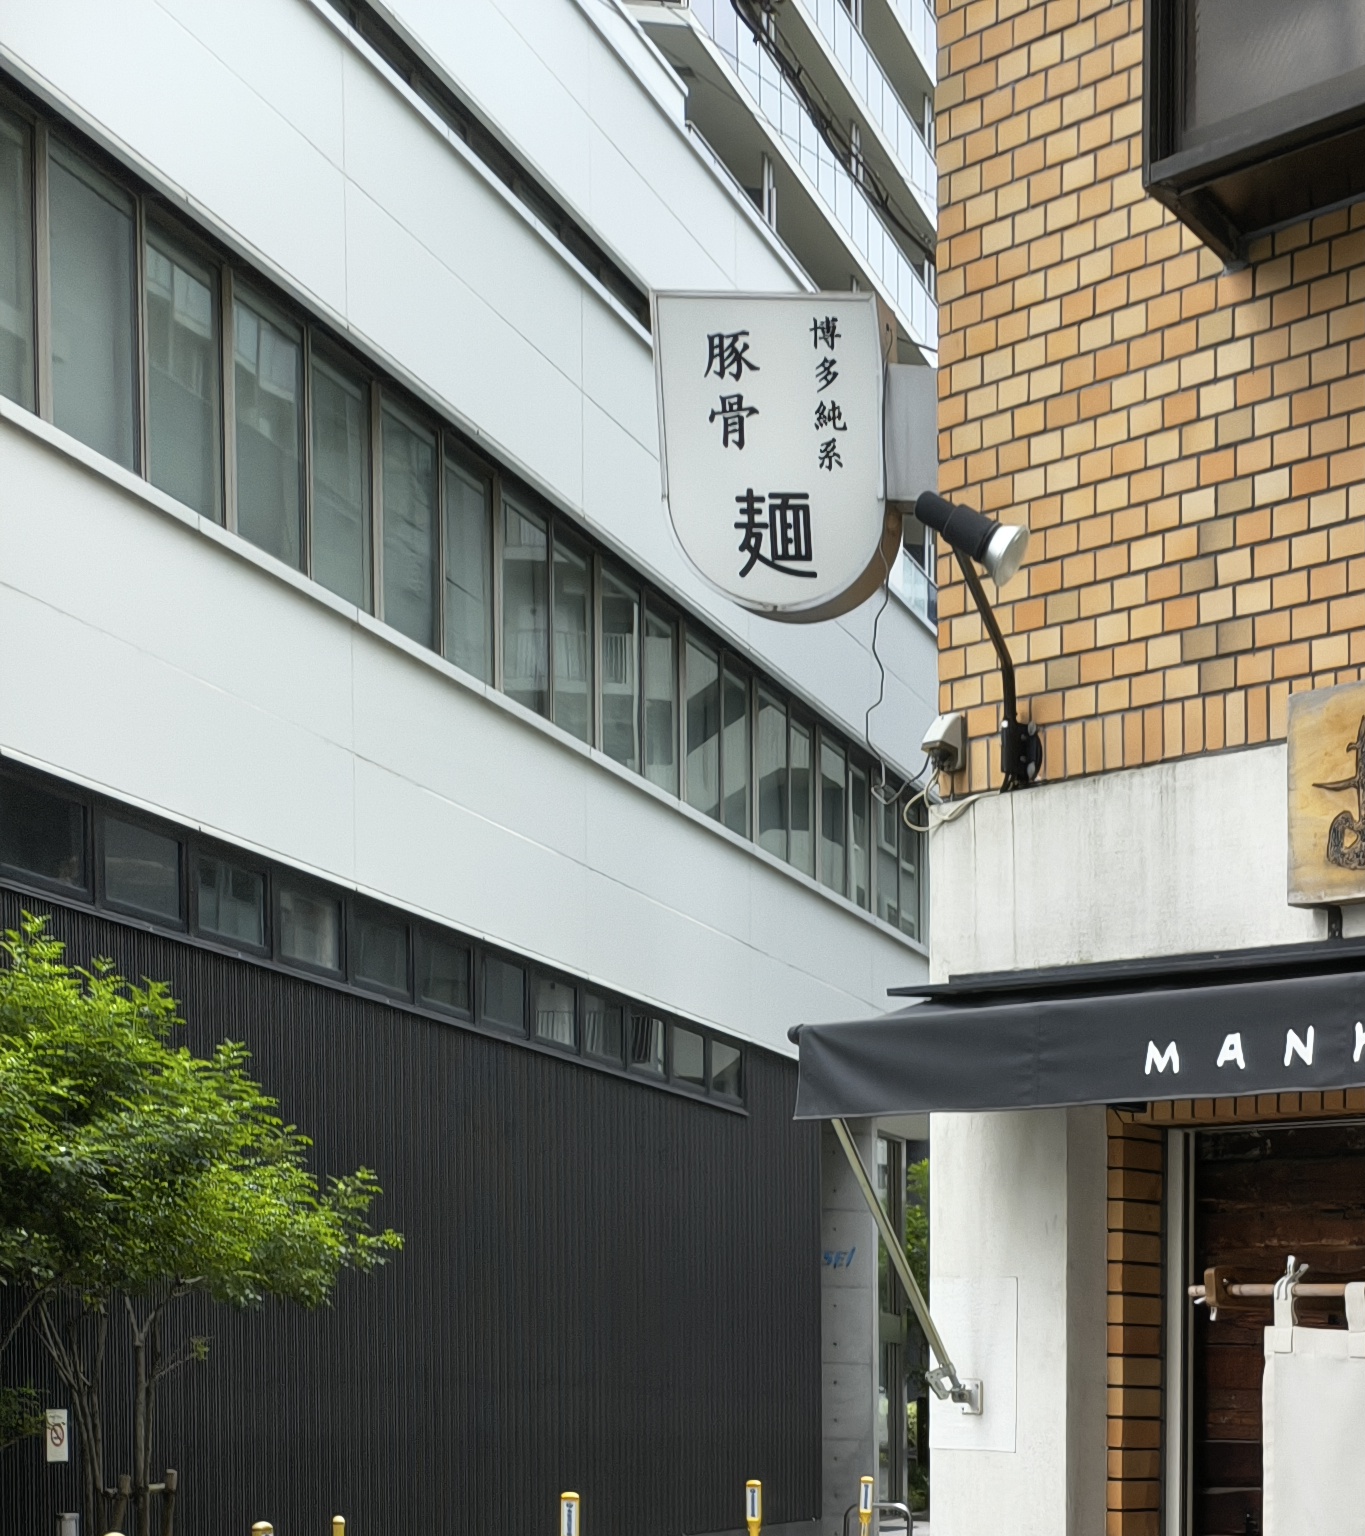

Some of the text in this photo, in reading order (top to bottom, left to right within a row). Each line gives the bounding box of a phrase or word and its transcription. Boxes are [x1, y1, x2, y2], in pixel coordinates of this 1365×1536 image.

[704, 330, 761, 451] 豚骨
[809, 315, 848, 472] 博多純系
